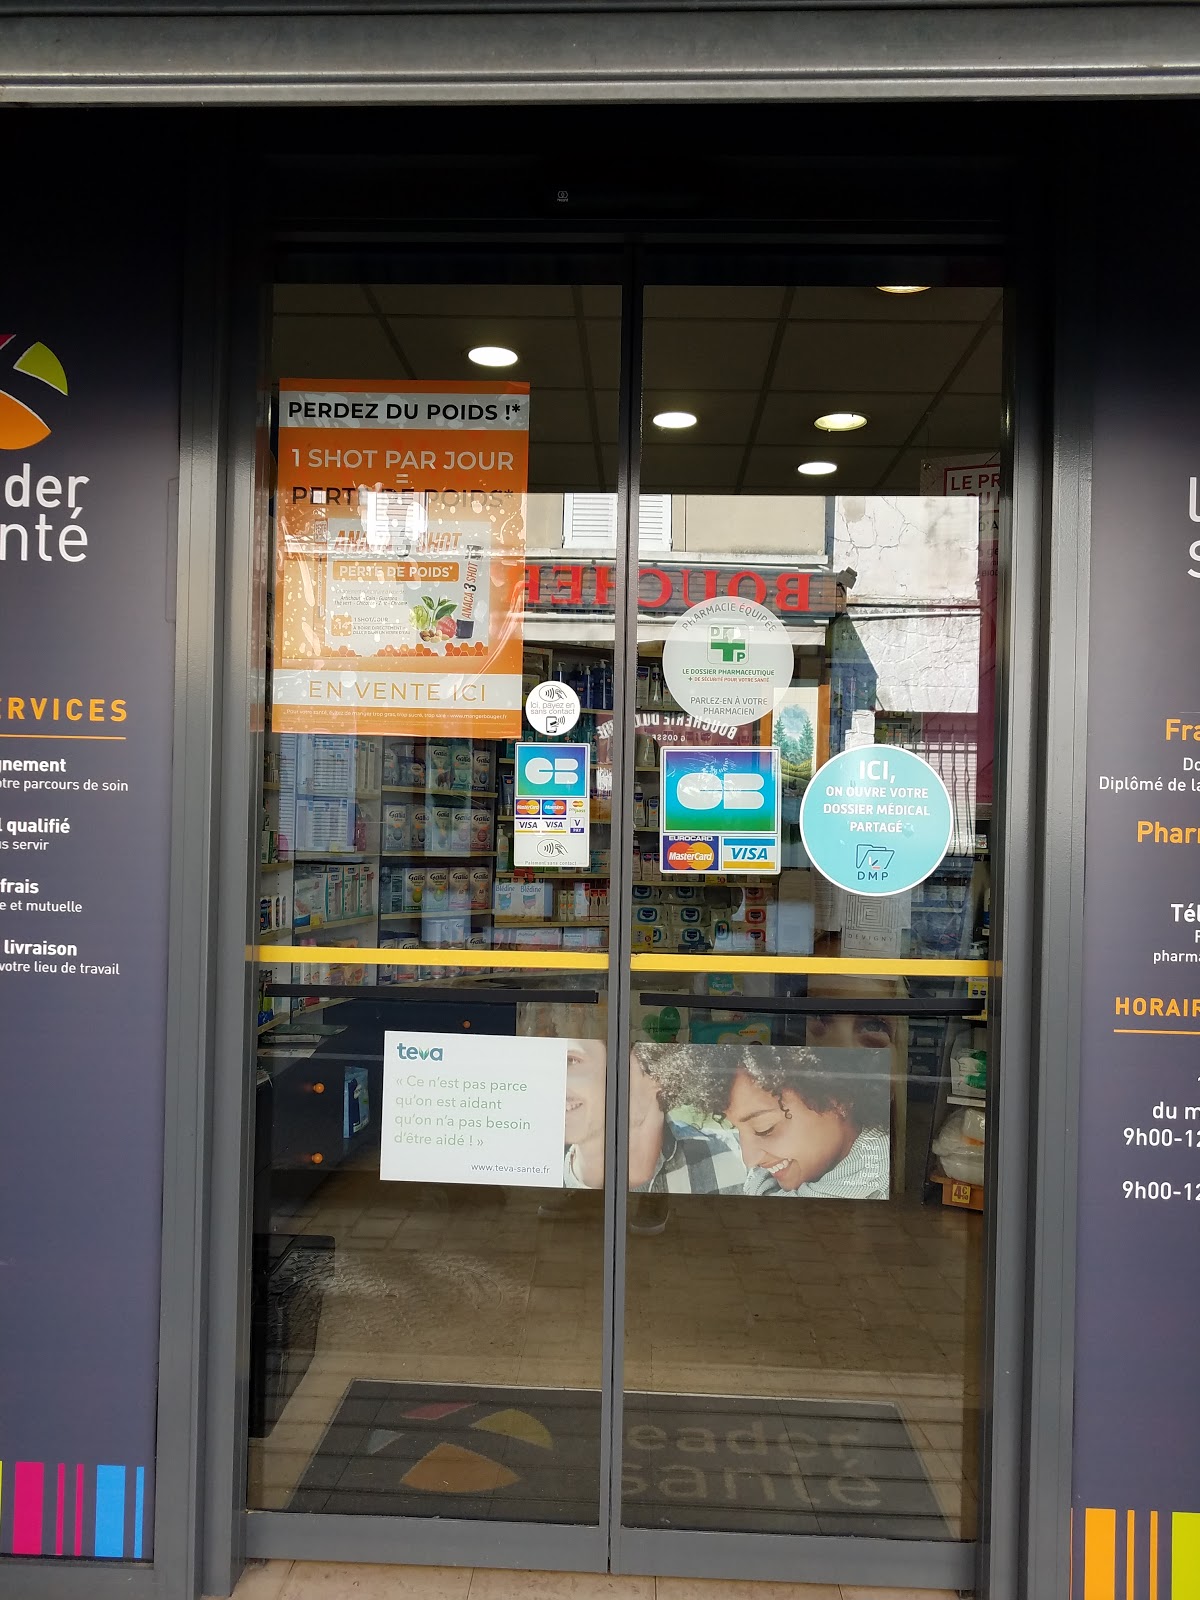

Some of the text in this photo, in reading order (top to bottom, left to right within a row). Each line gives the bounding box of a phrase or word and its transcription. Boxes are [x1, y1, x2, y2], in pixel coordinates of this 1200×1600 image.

[288, 401, 379, 420] PERDEZ
[386, 403, 419, 420] DU
[427, 404, 498, 421] POIDS
[291, 448, 515, 471] 1 SHOT PAR JOUR
[4, 463, 90, 508] der
[951, 475, 973, 491] LE
[292, 486, 365, 506] PERT
[0, 507, 88, 562] nté
[339, 565, 384, 577] PERTE
[387, 566, 405, 577] DE
[465, 561, 479, 583] SHOT
[682, 603, 777, 632] PHARMACIE ÉQUIPÉE
[736, 651, 746, 662] P
[718, 669, 775, 677] PHARMACEUTIQUE
[309, 680, 485, 702] EN VENTE ICI
[542, 702, 564, 710] payez
[691, 695, 768, 706] PARLEZ-EN À VOTRE
[0, 697, 127, 722] RVICES
[703, 707, 755, 716] PHARMACIEN
[0, 759, 67, 773] nement
[859, 759, 896, 784] ICI,
[23, 779, 80, 792] parcours
[83, 778, 99, 791] de
[102, 779, 129, 792] soin
[825, 785, 929, 799] ON OUVRE VOTRE
[1099, 775, 1187, 794] Diplômé de
[823, 803, 931, 816] DOSSIER MÉDICAL
[6, 817, 71, 836] qualifié
[518, 821, 538, 829] VISA
[545, 821, 564, 829] VISA
[849, 820, 904, 833] PARTAGÉ
[1137, 820, 1200, 844] Phar
[12, 838, 50, 851] servir
[668, 851, 713, 861] MasterCard
[730, 847, 769, 861] VISA
[857, 871, 889, 881] DMP
[0, 878, 40, 894] frais
[9, 900, 83, 912] et mutuelle
[4, 939, 78, 956] livraison
[1153, 949, 1200, 965] pharm
[0, 960, 121, 975] votre lieu de travail
[396, 1042, 444, 1062] teva
[406, 1075, 425, 1088] Ce
[428, 1075, 460, 1089] n'est
[462, 1079, 487, 1092] pas
[490, 1081, 528, 1094] parce
[395, 1094, 503, 1110] qu'on est aidant
[1152, 1101, 1177, 1120] du
[394, 1113, 531, 1130] qu'on n'a pas besoin
[394, 1131, 432, 1145] d'être
[436, 1133, 465, 1147] aidé
[861, 1143, 880, 1151] Pour
[470, 1162, 551, 1175] www.teva-sante.fr
